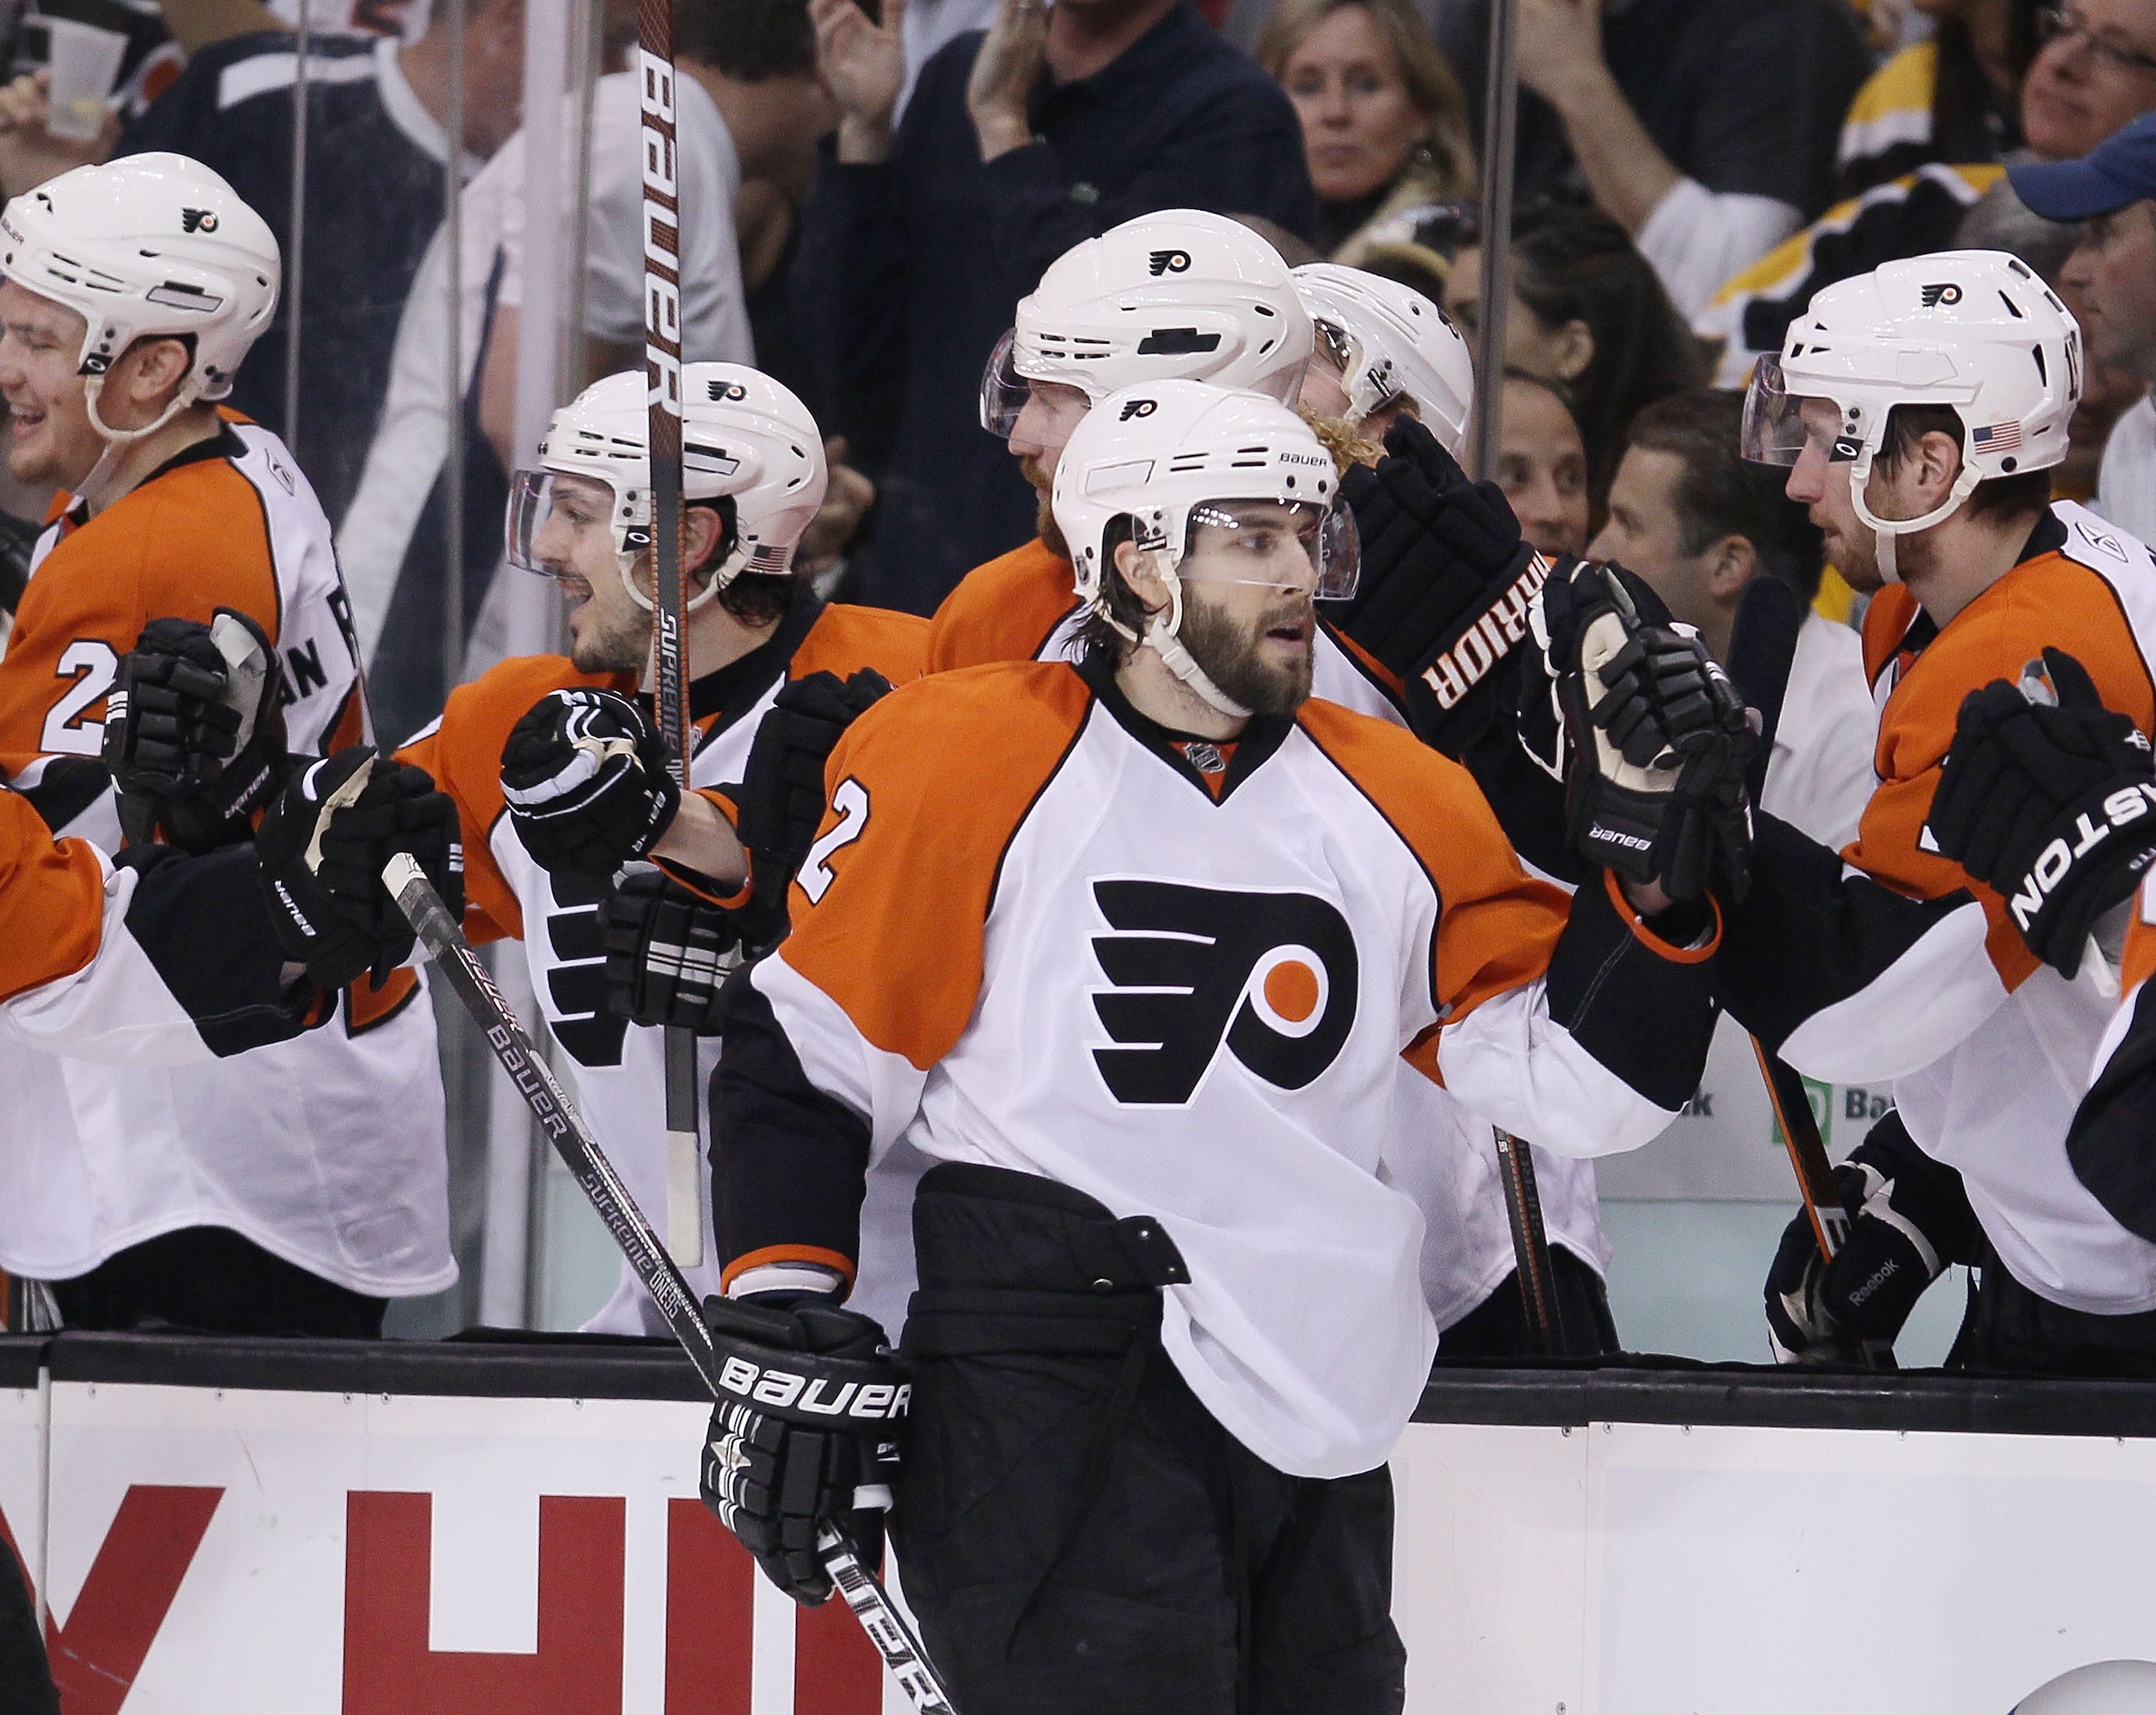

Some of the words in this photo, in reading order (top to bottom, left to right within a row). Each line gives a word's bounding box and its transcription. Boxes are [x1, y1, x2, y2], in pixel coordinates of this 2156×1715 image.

[639, 48, 683, 418] BAUER
[1278, 452, 1327, 467] BAUER
[659, 607, 681, 755] SUPREME
[796, 774, 871, 907] 2
[1588, 821, 1652, 852] BAUER
[462, 948, 523, 1032] BAUER
[487, 1023, 568, 1139] BAUER
[580, 1173, 653, 1274] SUPREME
[1849, 1258, 1900, 1306] Reebok
[718, 1356, 912, 1418] BAUER
